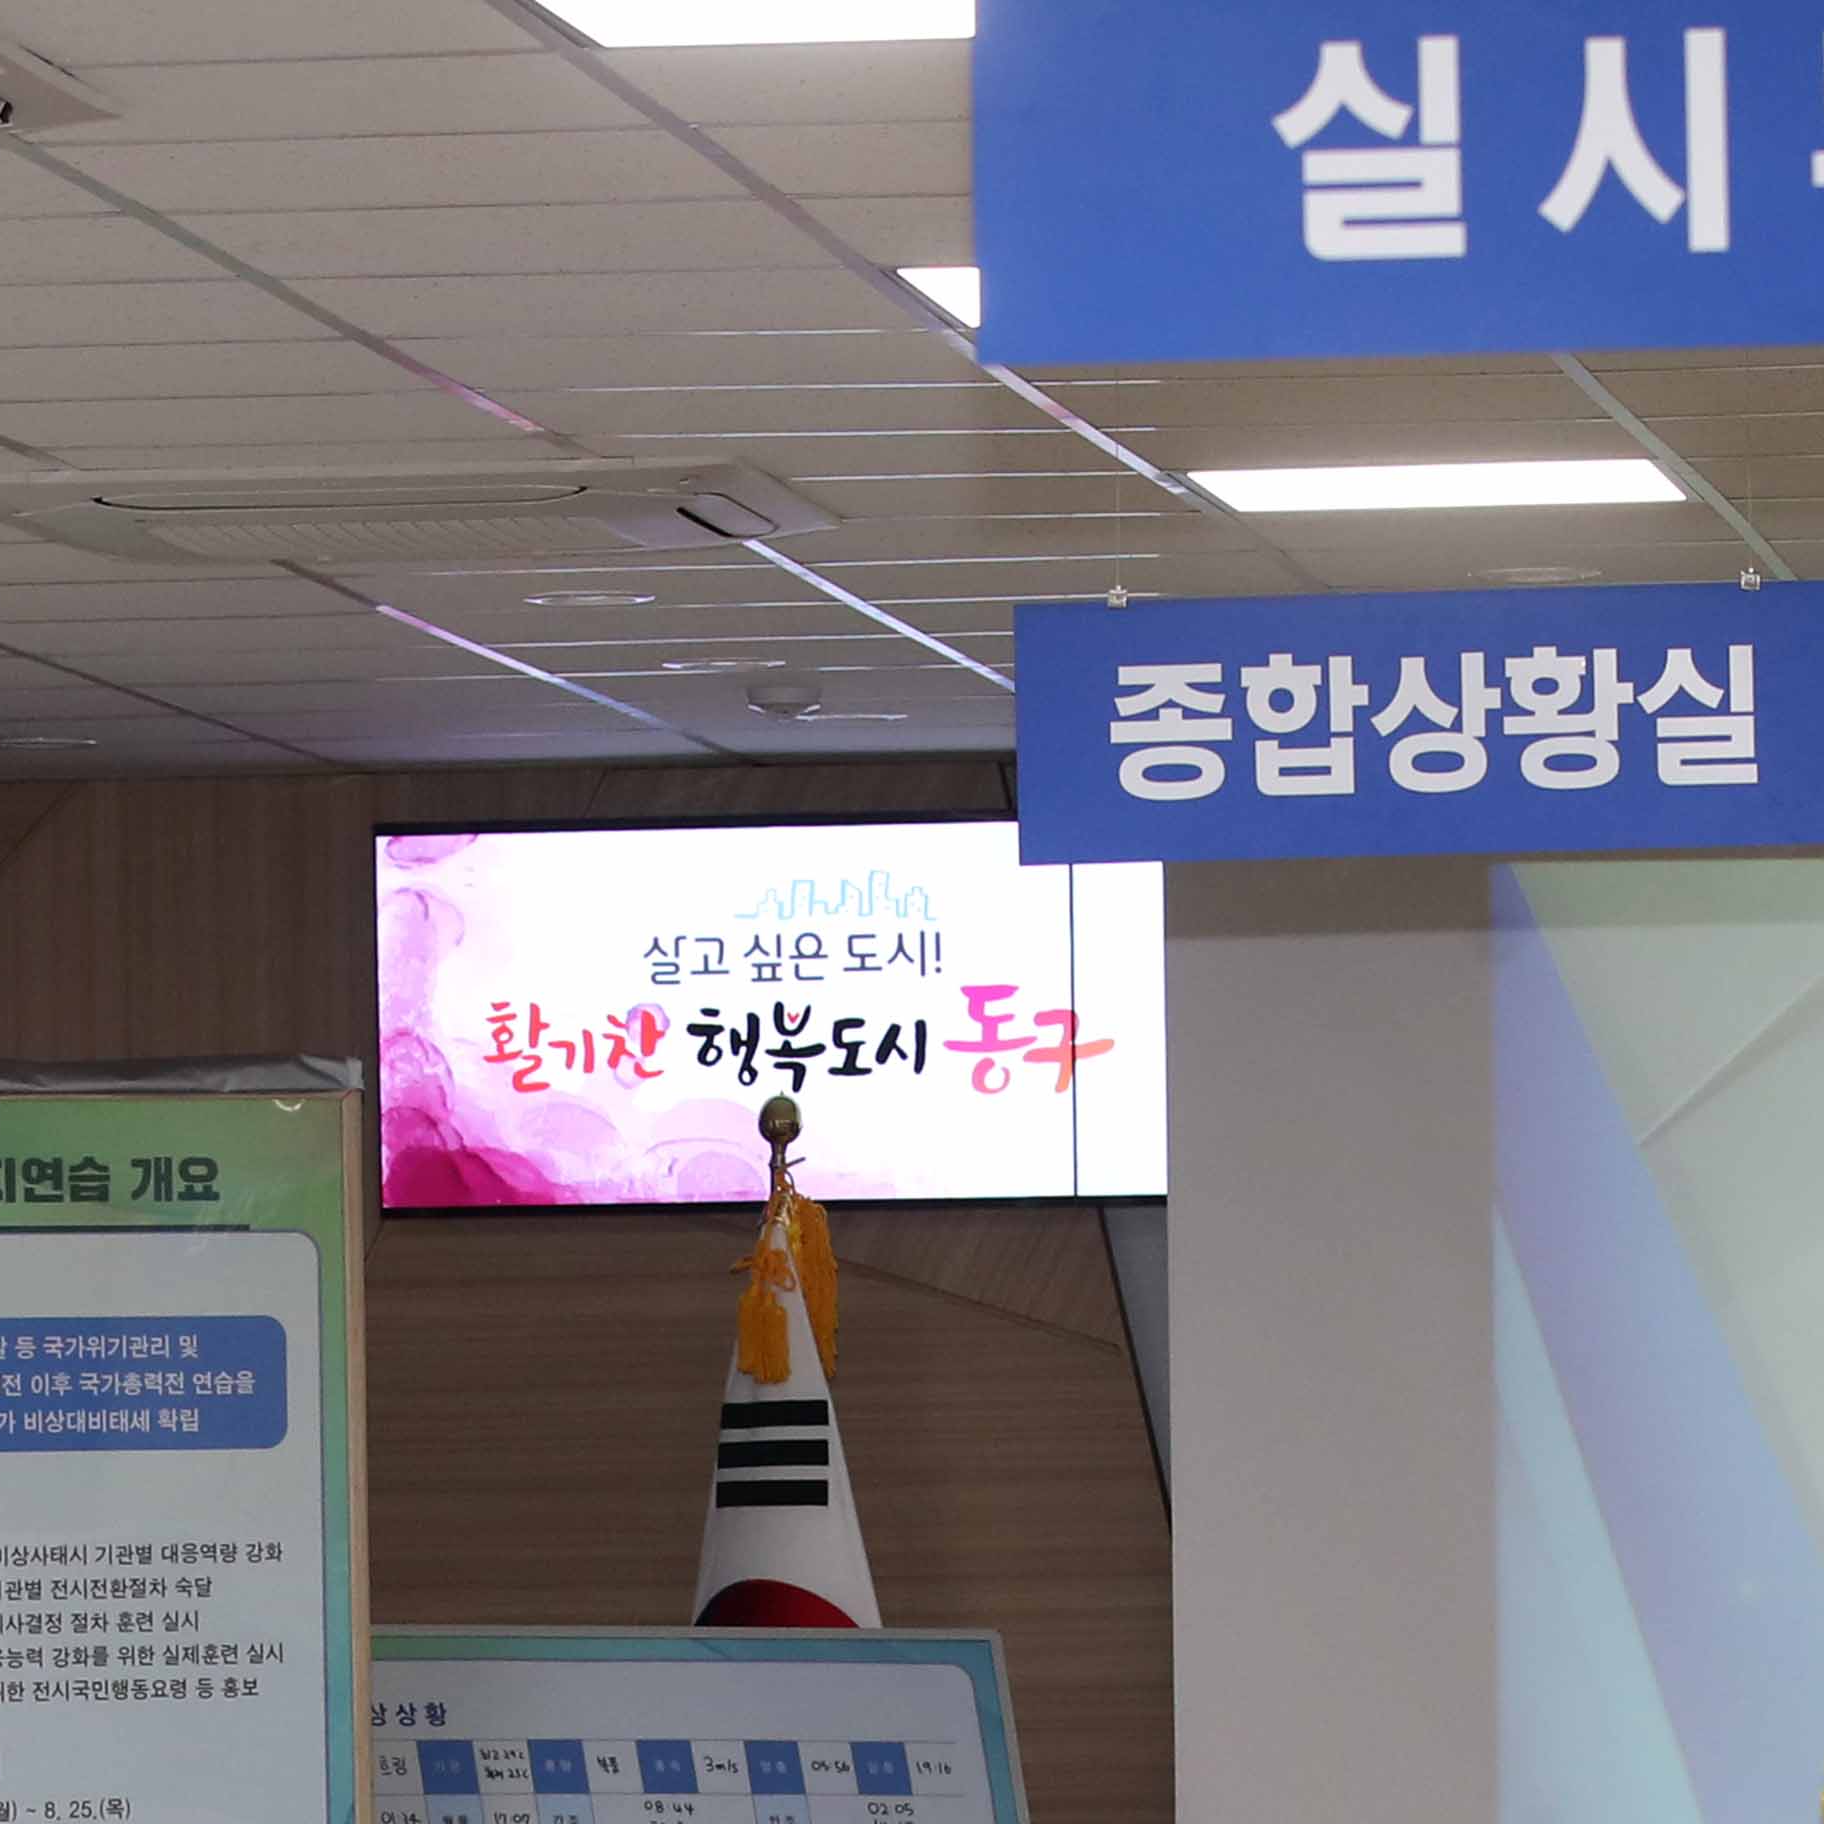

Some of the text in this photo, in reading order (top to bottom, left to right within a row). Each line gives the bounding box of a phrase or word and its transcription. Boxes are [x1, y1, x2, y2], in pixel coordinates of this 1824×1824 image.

[1109, 644, 1761, 801] 종합상황실
[644, 930, 944, 986] 살고 싶은 도시!
[484, 985, 1115, 1094] 활기찬 행복도시 동구
[131, 1156, 221, 1203] 개요
[15, 1335, 36, 1361] 등
[43, 1334, 171, 1360] 국가위기관리
[178, 1333, 198, 1359] 및
[31, 1372, 72, 1397] 이후
[80, 1371, 185, 1396] 국가총력전
[193, 1370, 254, 1394] 연습을
[24, 1409, 150, 1434] 비상대비태세
[158, 1408, 199, 1433] 확립
[94, 1543, 153, 1566] 기관별
[161, 1542, 239, 1565] 대응역량
[245, 1541, 283, 1564] 강화
[51, 1577, 167, 1600] 전시전환절차
[175, 1576, 212, 1599] 숙달
[70, 1611, 108, 1633] 절차
[116, 1610, 154, 1632] 훈련
[161, 1609, 198, 1632] 실시
[51, 1645, 110, 1667] 강화를
[117, 1644, 155, 1666] 위한
[161, 1643, 239, 1665] 실제훈련
[245, 1641, 284, 1664] 실시
[31, 1677, 188, 1701] 전시국민행동요령
[194, 1677, 214, 1699] 등
[220, 1676, 259, 1699] 홍보
[44, 1801, 63, 1821] 8.
[68, 1798, 131, 1821] 25.(목)
